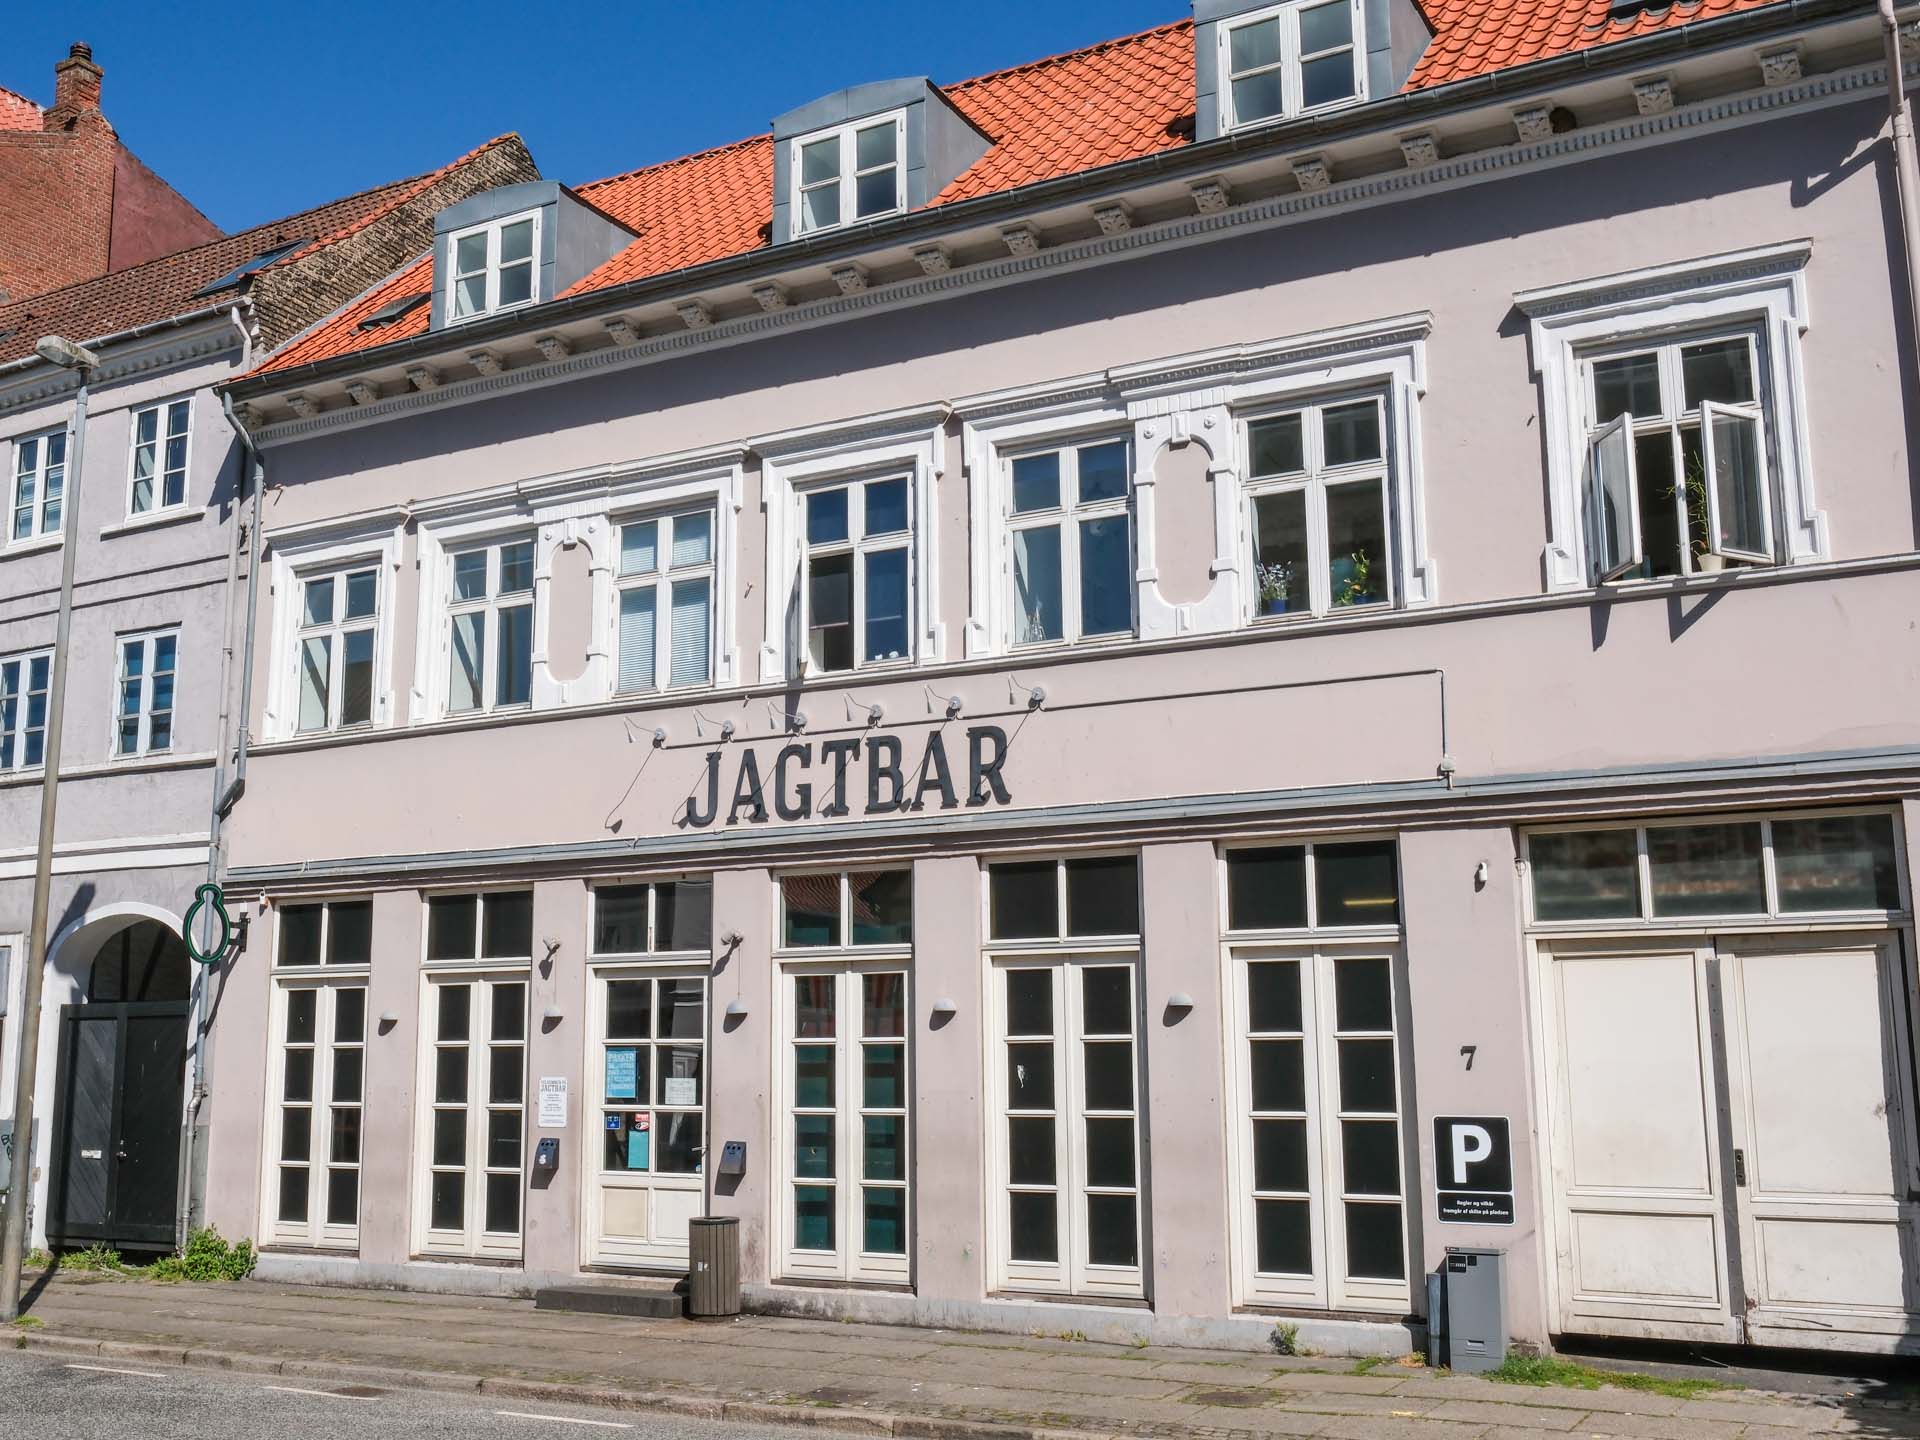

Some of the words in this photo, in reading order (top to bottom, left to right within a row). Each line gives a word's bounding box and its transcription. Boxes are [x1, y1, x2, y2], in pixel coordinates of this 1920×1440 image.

[686, 725, 1012, 829] JAGTBAR
[1460, 1045, 1477, 1071] 7
[1451, 1124, 1492, 1183] P
